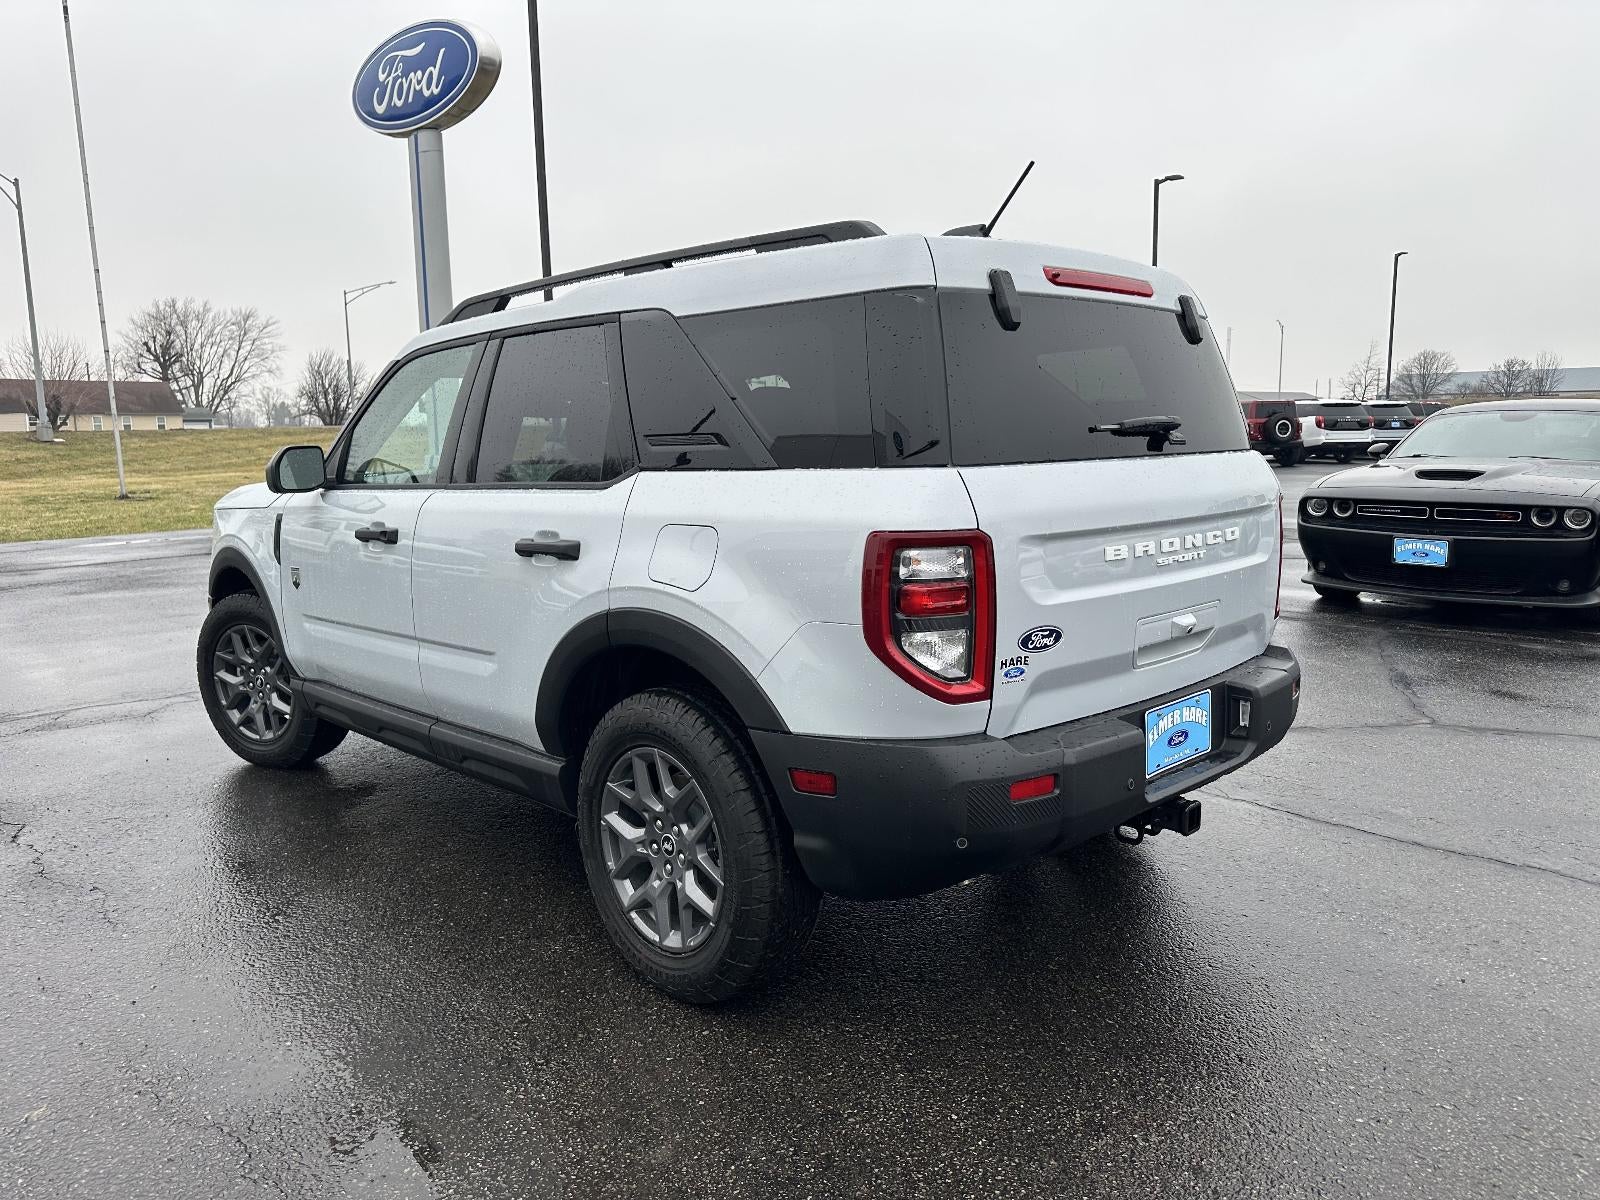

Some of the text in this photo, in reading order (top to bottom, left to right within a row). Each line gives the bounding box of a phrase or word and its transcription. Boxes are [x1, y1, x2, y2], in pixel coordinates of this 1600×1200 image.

[373, 41, 446, 115] Ford
[1104, 526, 1240, 562] BRONCO
[1397, 542, 1446, 556] ELMER HARE
[1156, 549, 1207, 566] SPORT
[1028, 630, 1057, 649] Ford
[1000, 655, 1030, 671] HARE
[1148, 706, 1208, 748] ELMER HARE
